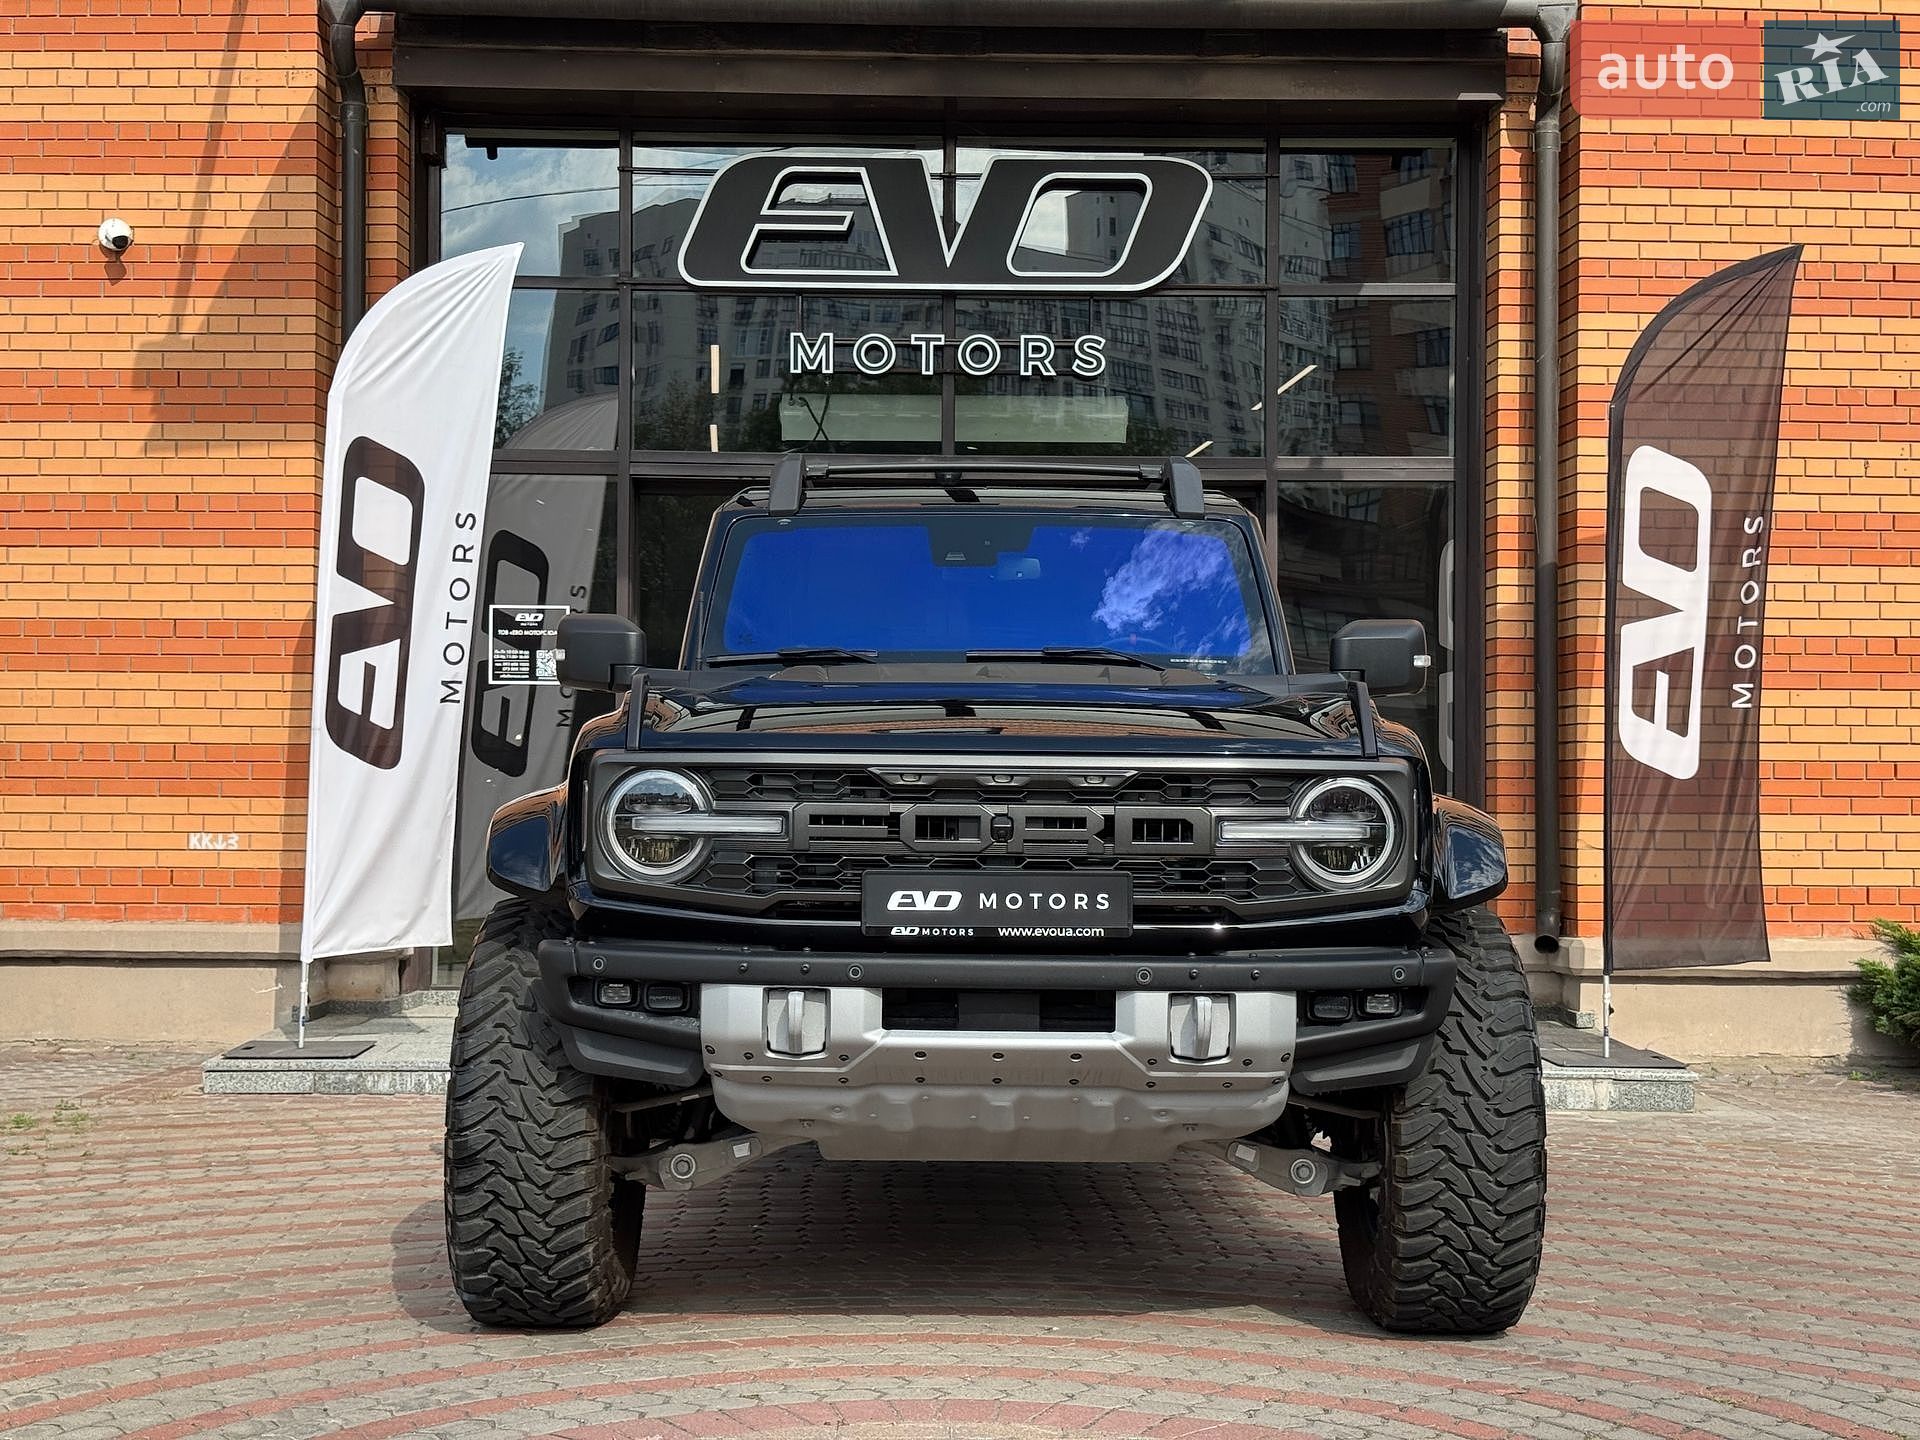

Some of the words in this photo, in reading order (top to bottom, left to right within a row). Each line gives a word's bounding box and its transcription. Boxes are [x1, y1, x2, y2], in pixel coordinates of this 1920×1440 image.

[678, 152, 1213, 291] EVO
[789, 332, 1106, 377] MOTORS
[325, 436, 425, 770] EVO
[440, 512, 477, 704] MOTORS
[1618, 445, 1712, 780] EVO
[1732, 516, 1764, 709] MOTORS
[791, 802, 1213, 855] FORD
[887, 891, 963, 911] EVO
[979, 893, 1110, 910] MOTORS
[891, 927, 920, 935] EVO
[922, 928, 974, 936] MOTORS
[998, 927, 1104, 937] www.evoua.com
